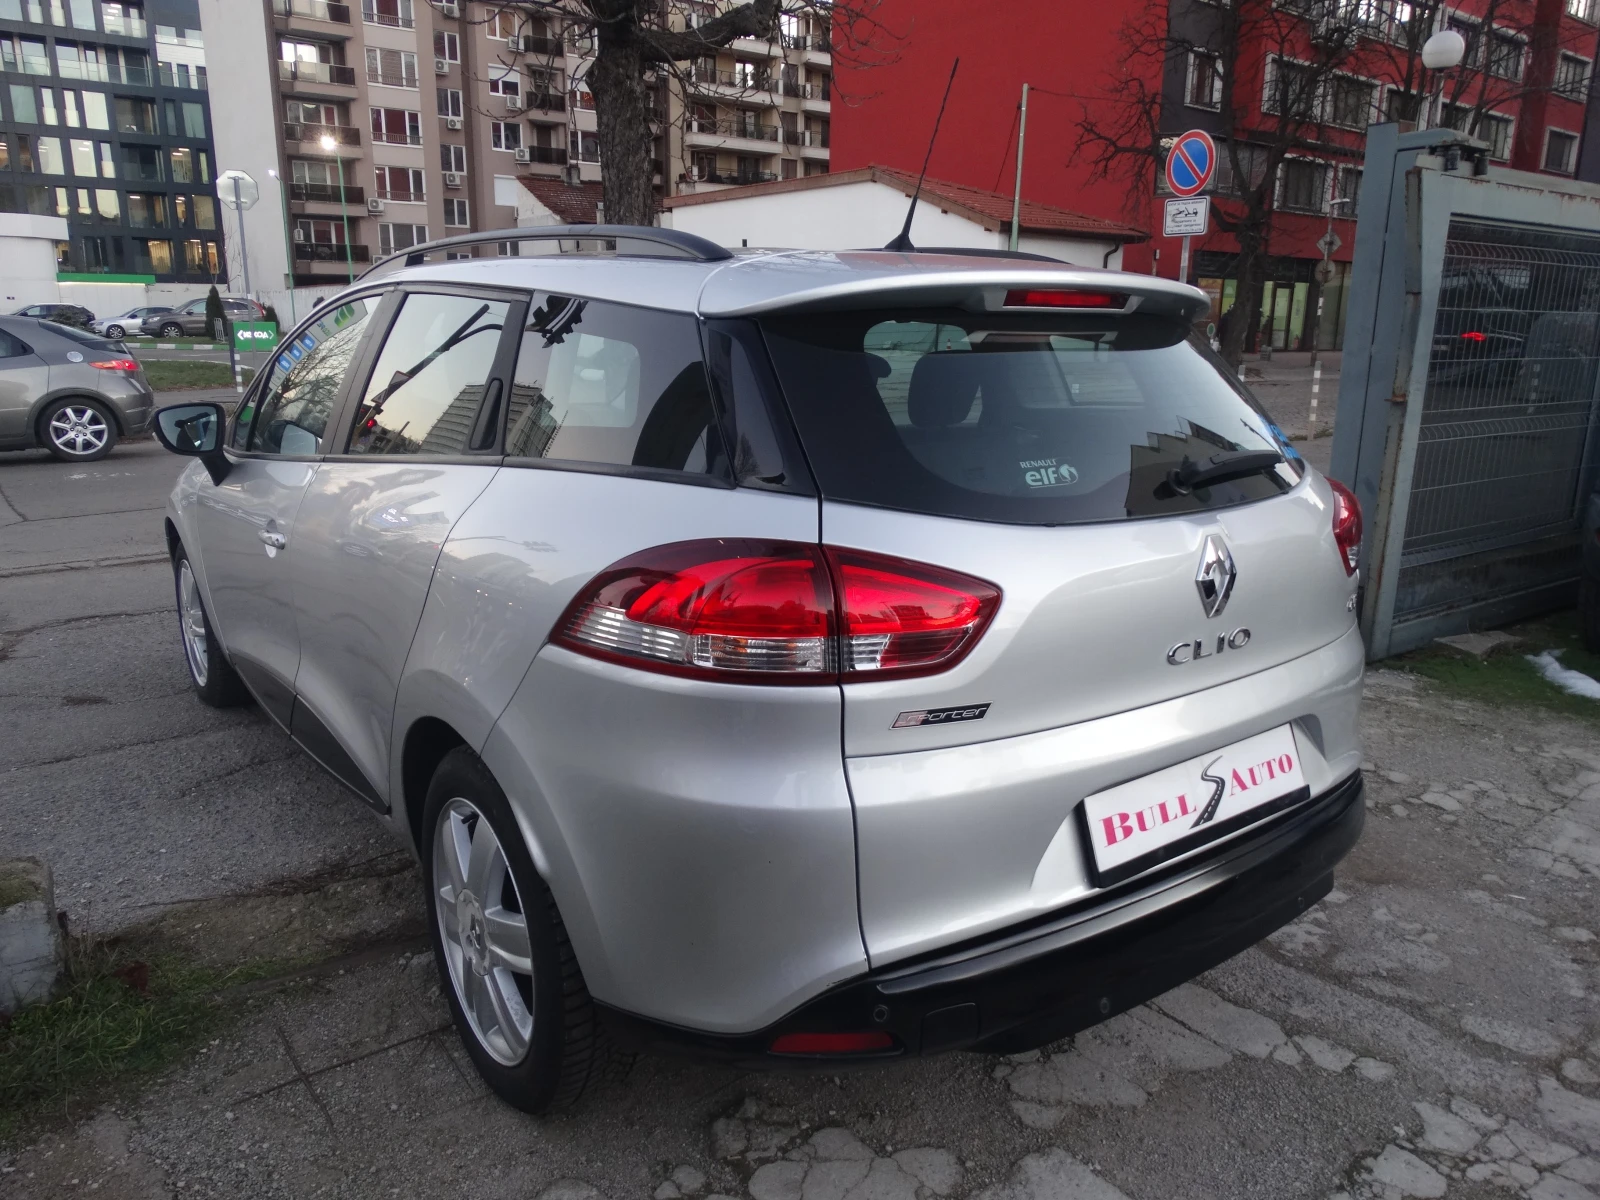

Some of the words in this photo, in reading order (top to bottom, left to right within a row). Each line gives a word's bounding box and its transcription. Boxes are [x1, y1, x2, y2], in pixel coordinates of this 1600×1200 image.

[1019, 459, 1057, 468] RENAULT
[1025, 467, 1058, 486] elf
[1166, 626, 1251, 666] CLIO
